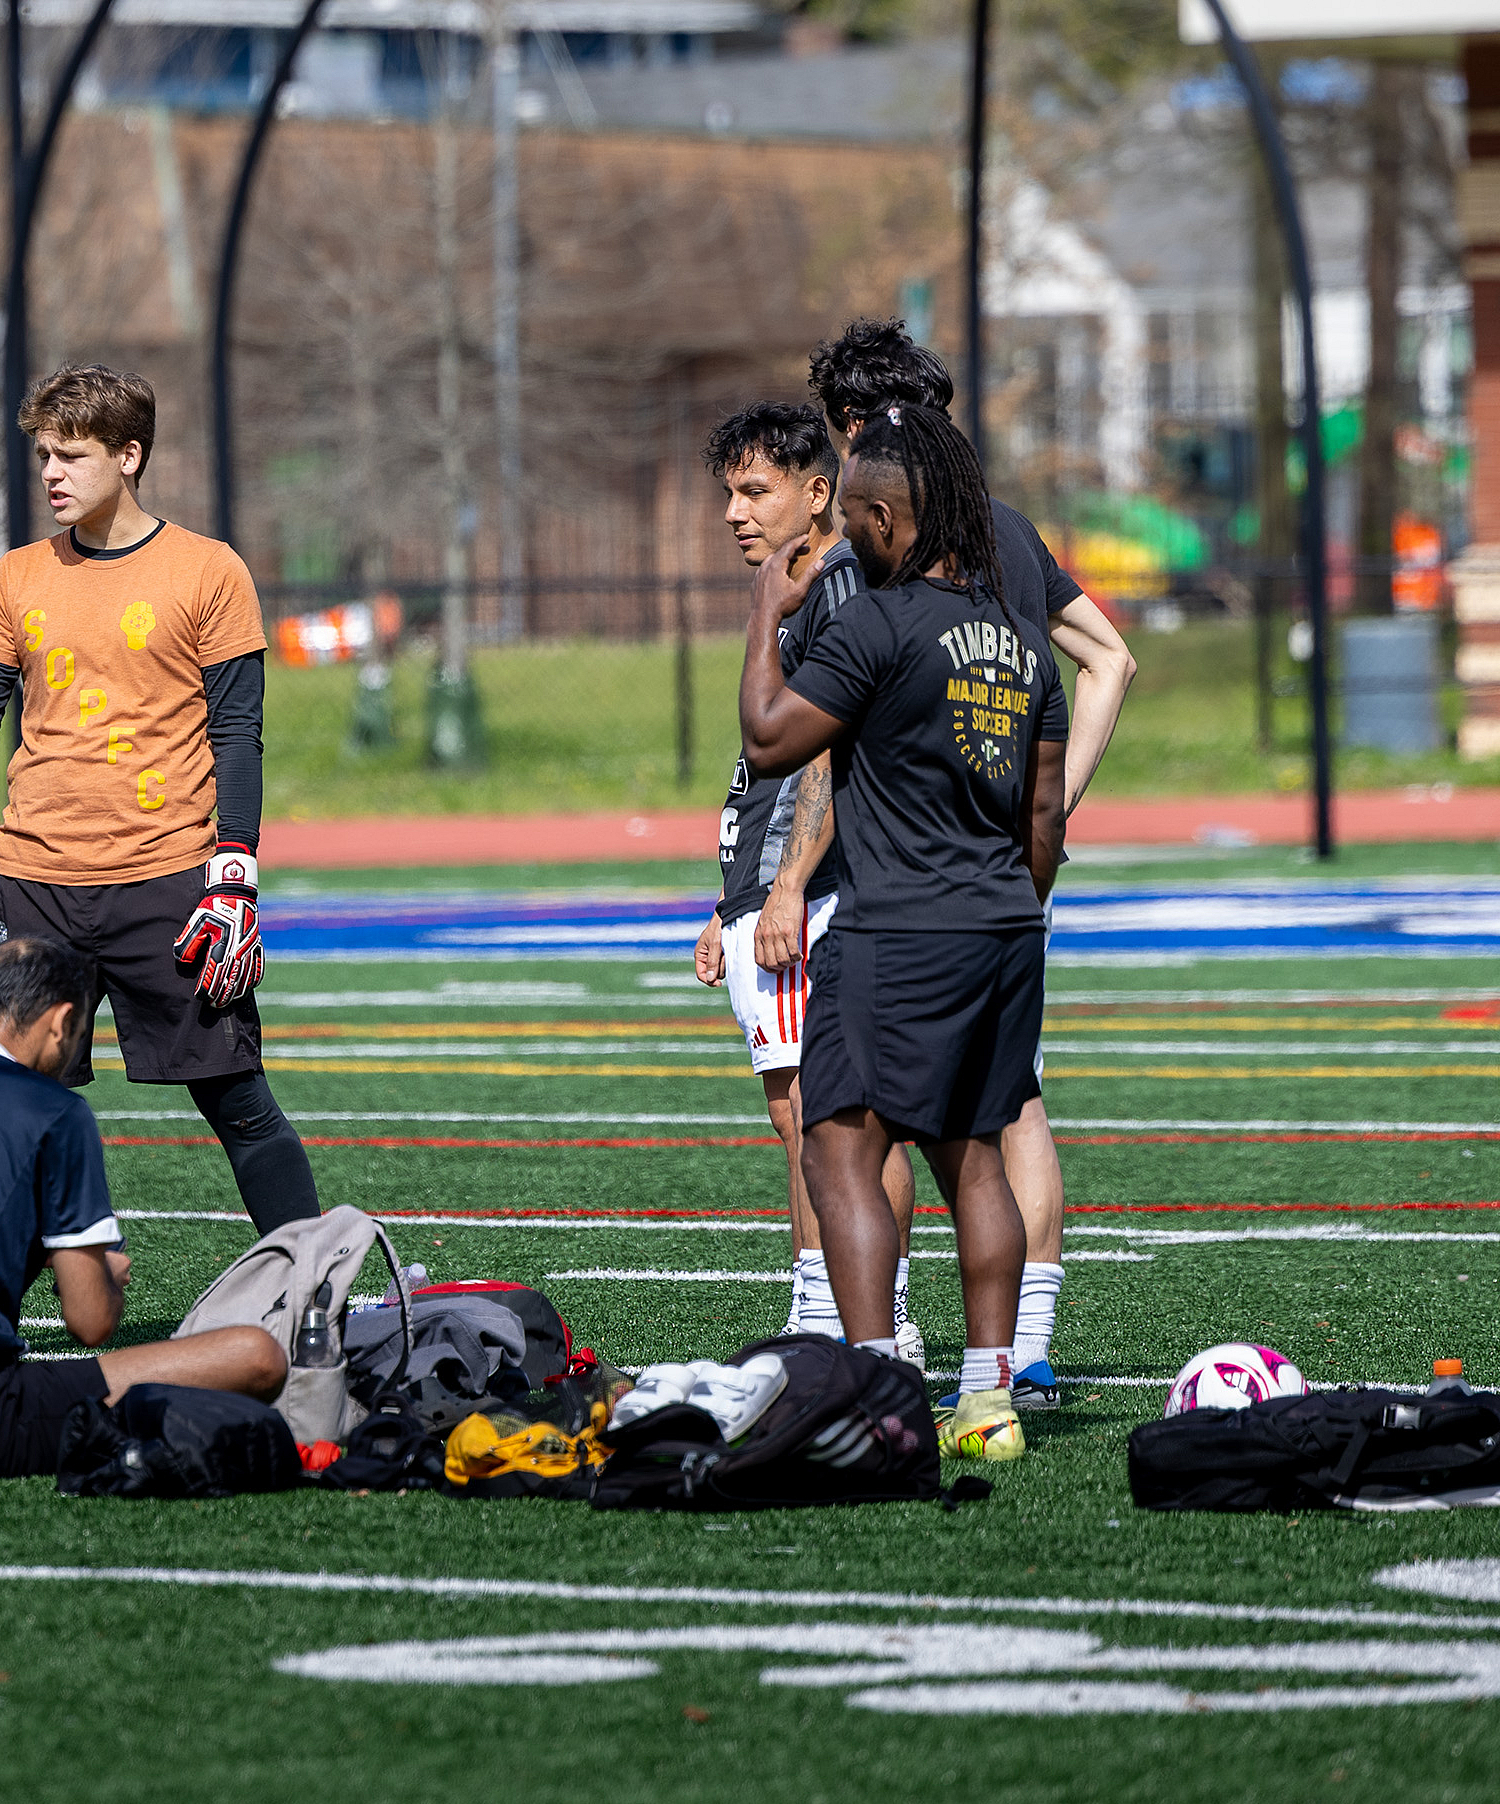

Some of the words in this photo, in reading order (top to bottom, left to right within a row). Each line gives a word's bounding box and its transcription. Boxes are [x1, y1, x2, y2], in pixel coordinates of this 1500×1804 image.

[937, 621, 1038, 686] TIMBERS
[946, 678, 990, 707] MAJOR
[991, 685, 1031, 716] LEAUE
[971, 706, 1012, 737] SOCCER
